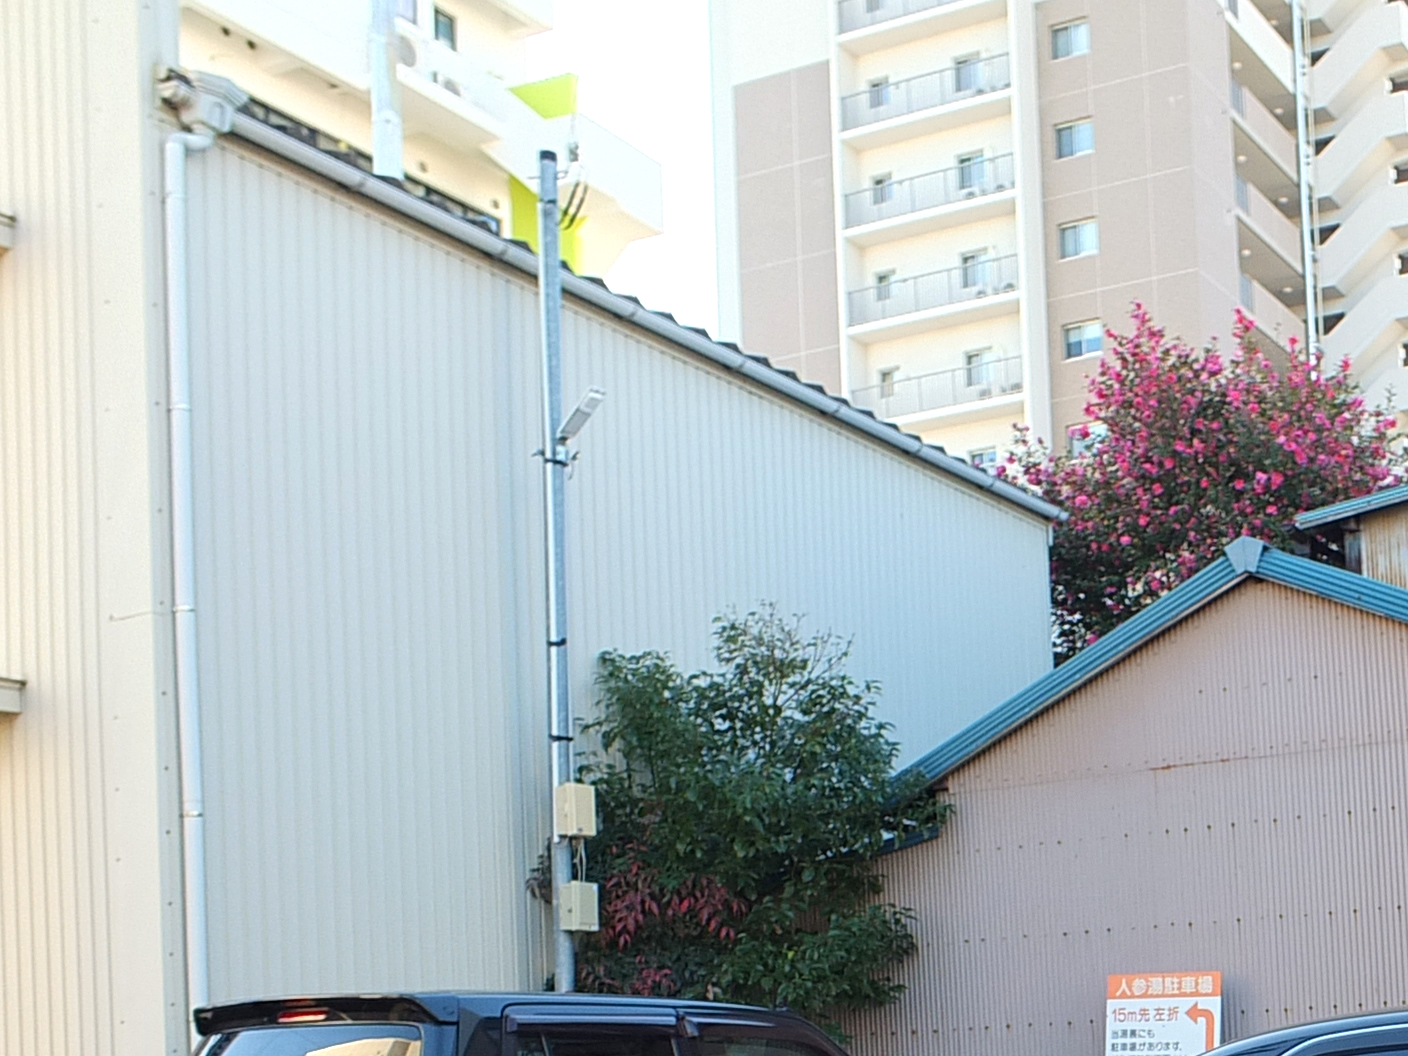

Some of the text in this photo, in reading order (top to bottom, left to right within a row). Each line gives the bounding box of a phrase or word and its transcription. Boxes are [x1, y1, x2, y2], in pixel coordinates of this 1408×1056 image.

[1115, 976, 1213, 996] 人参湯駐車場
